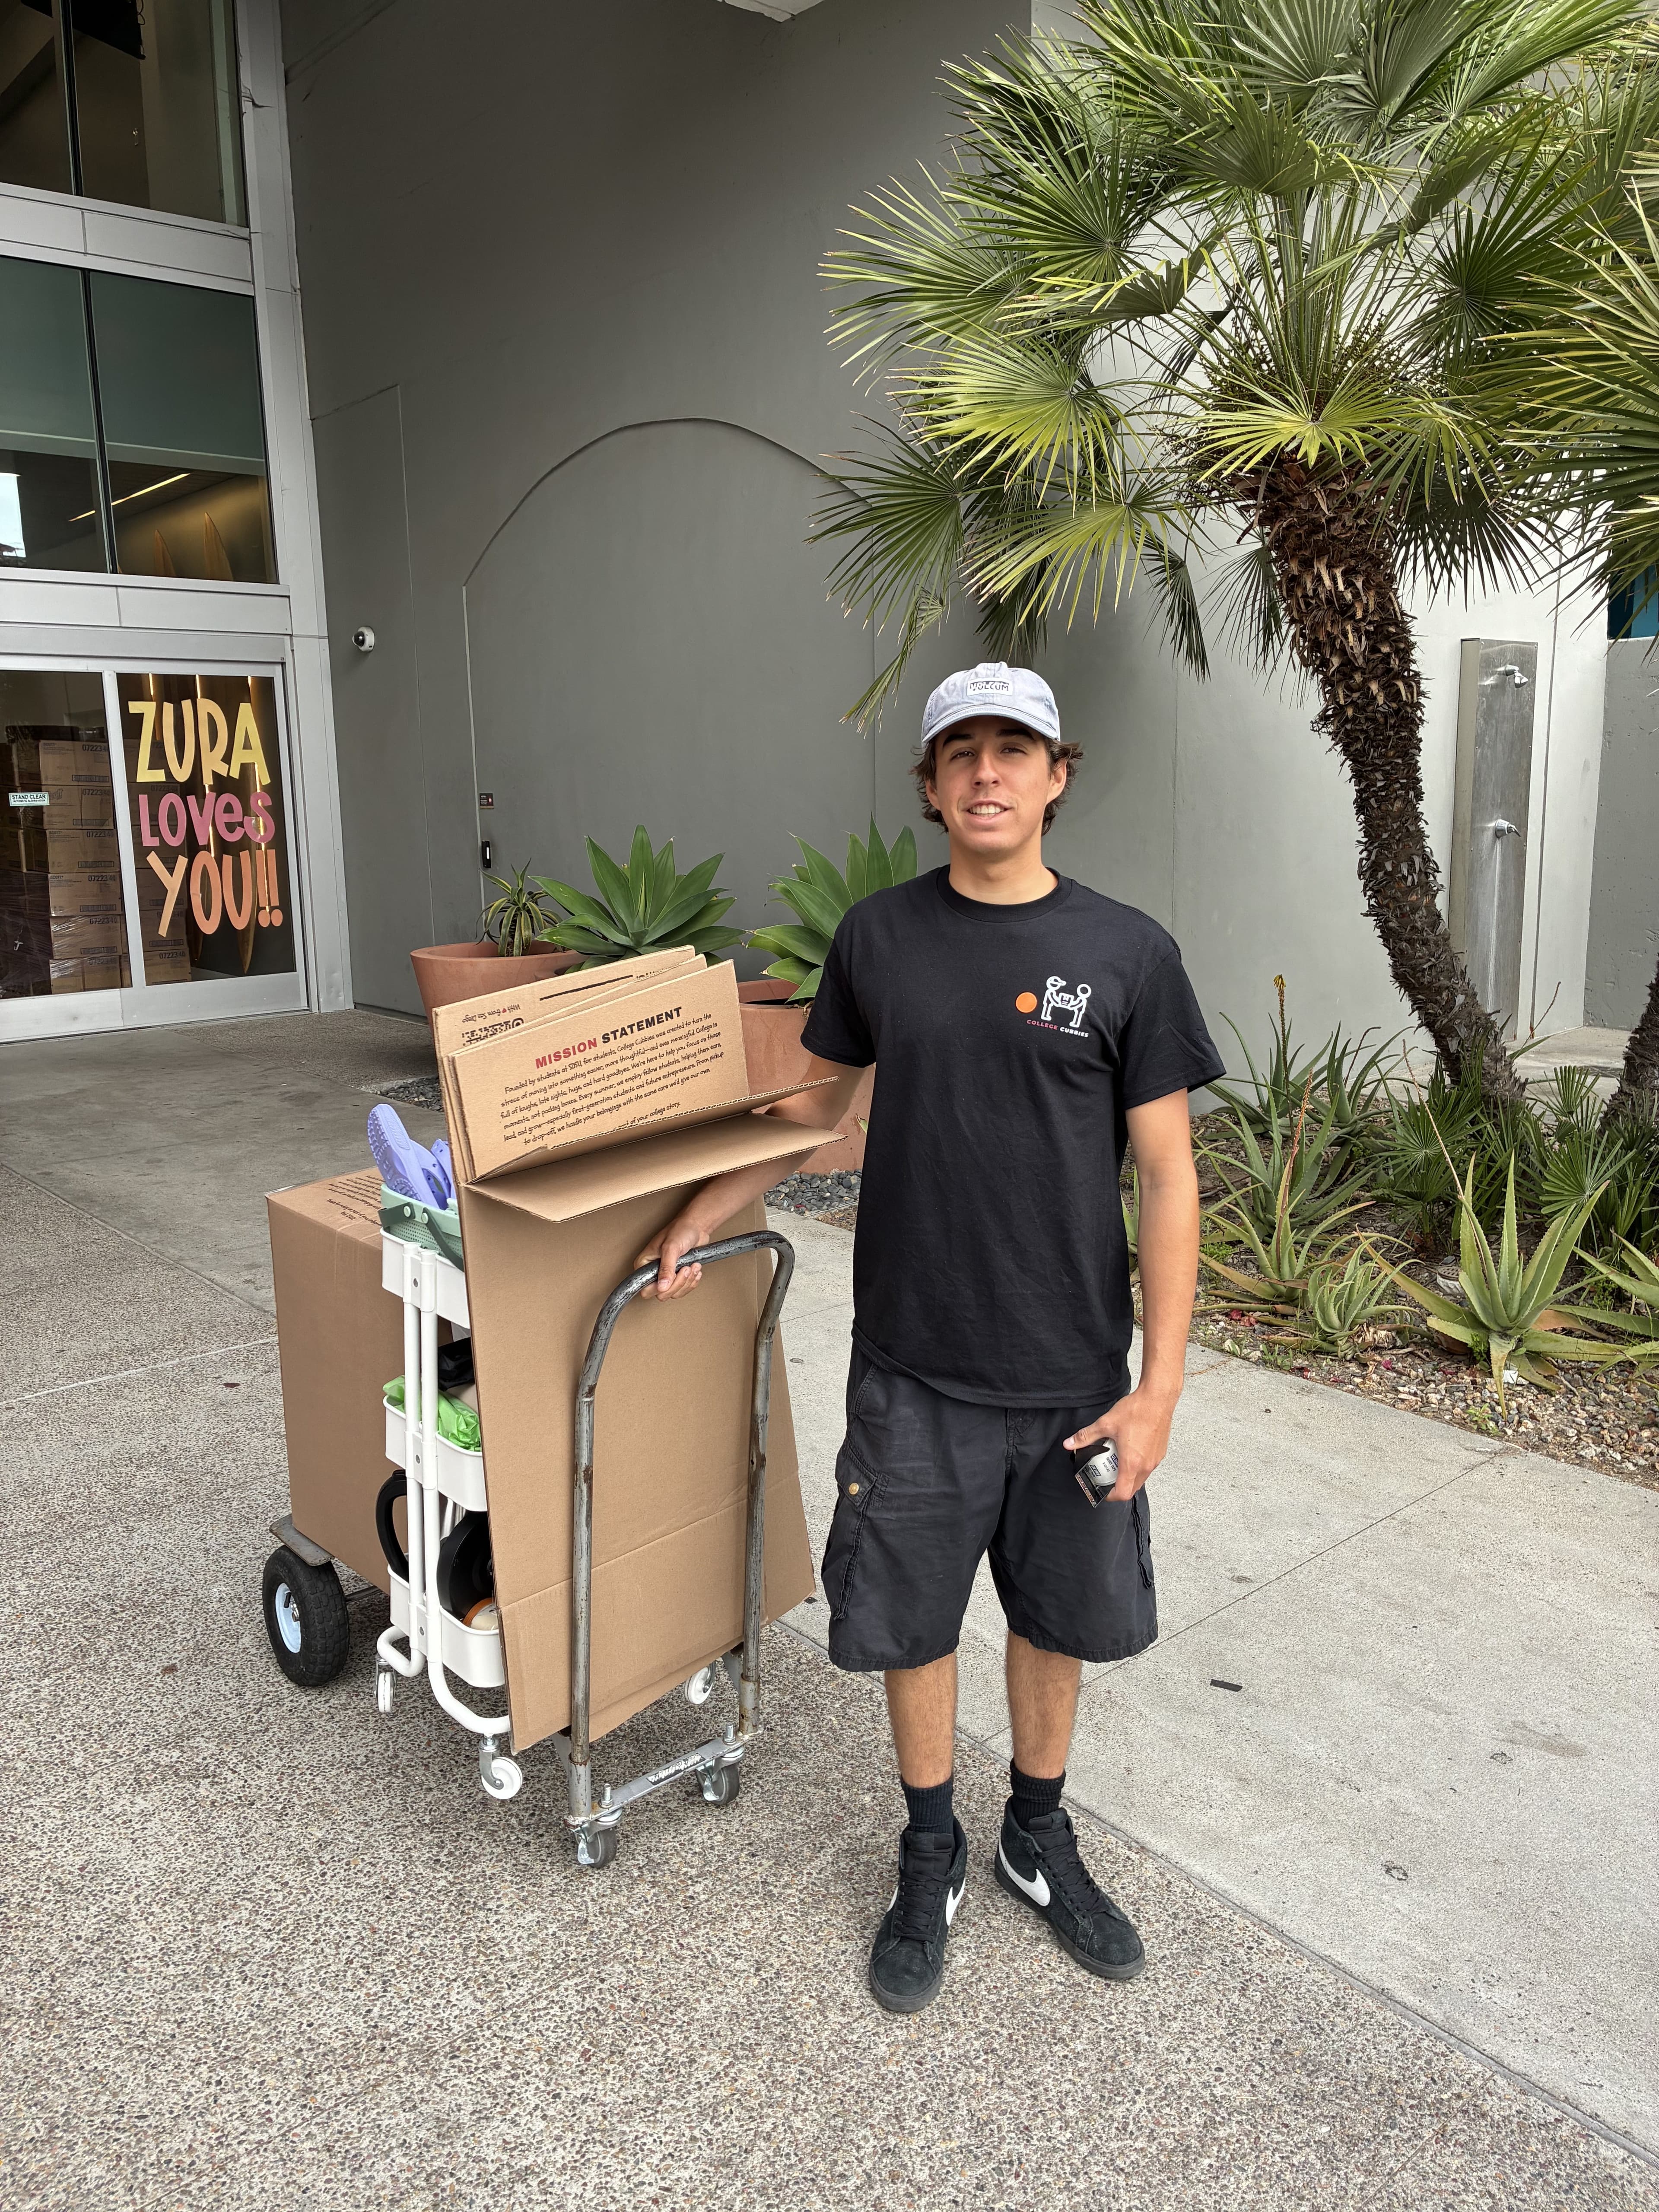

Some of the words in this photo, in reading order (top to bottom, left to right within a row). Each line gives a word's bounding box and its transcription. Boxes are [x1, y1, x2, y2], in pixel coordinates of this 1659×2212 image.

[128, 698, 271, 785] ZURA
[146, 849, 283, 938] YOU!!
[501, 1097, 520, 1107] stress
[521, 1091, 530, 1099] of
[528, 1086, 547, 1097] moving
[547, 1081, 559, 1090] into
[559, 1071, 586, 1085] something
[605, 1059, 619, 1068] more
[696, 1024, 712, 1033] College
[505, 1080, 528, 1094] Founded
[537, 1069, 561, 1082] students
[617, 1042, 635, 1052] College
[635, 1035, 655, 1046] Cubbies
[667, 1021, 685, 1034] created
[703, 1013, 712, 1021] the
[535, 1037, 597, 1069] MISSION
[601, 1006, 682, 1044] STATEMENT
[1027, 1019, 1058, 1030] COLLEGE
[1060, 1027, 1089, 1038] CUBBIES
[500, 1109, 511, 1119] full
[511, 1106, 521, 1115] of
[538, 1096, 550, 1105] late
[583, 1078, 593, 1088] and
[593, 1073, 605, 1084] hard
[630, 1060, 646, 1069] We're
[665, 1048, 675, 1056] help
[676, 1046, 686, 1055] you
[686, 1039, 700, 1049] focus
[707, 1032, 721, 1041] those
[517, 1126, 528, 1136] and
[613, 1086, 636, 1099] students
[636, 1081, 645, 1090] and
[645, 1076, 662, 1086] future
[696, 1058, 709, 1067] From
[709, 1052, 724, 1063] pickup
[531, 1110, 540, 1120] not
[578, 1091, 593, 1101] Every
[625, 1073, 642, 1083] employ
[643, 1067, 658, 1076] fellow
[681, 1052, 697, 1062] helping
[697, 1047, 710, 1055] them
[566, 1117, 582, 1128] handle
[582, 1113, 596, 1123] your
[596, 1103, 622, 1116] belongings
[622, 1096, 634, 1106] with
[634, 1093, 643, 1102] the
[644, 1089, 658, 1098] same
[669, 1077, 680, 1088] we'd
[680, 1076, 690, 1085] give
[630, 1116, 638, 1125] of
[636, 1114, 648, 1123] your
[649, 1107, 666, 1117] college
[666, 1101, 681, 1110] story.
